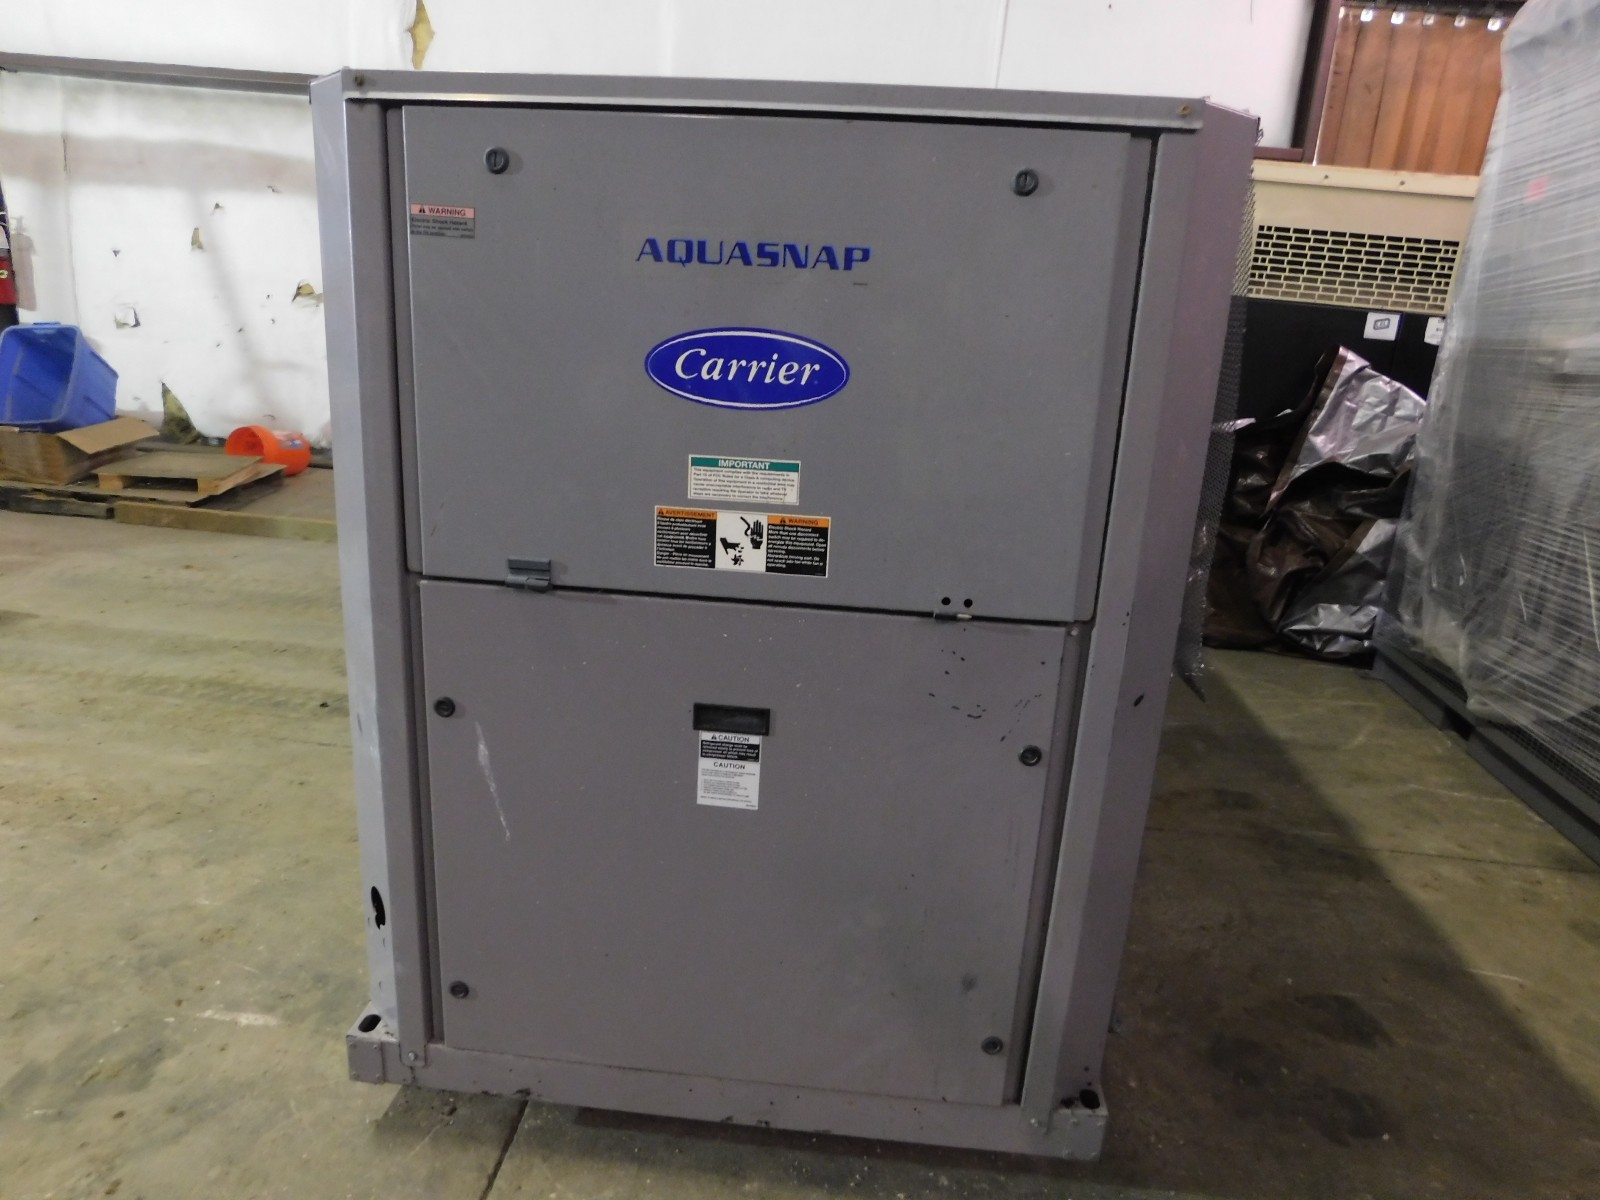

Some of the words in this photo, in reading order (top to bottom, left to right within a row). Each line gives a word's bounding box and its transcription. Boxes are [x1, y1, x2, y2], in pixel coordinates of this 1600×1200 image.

[429, 208, 465, 216] WARNING
[636, 238, 871, 271] AQUASNAP
[674, 348, 820, 386] Carrier
[718, 460, 771, 470] IMPORTANT
[665, 510, 715, 518] AVERTISSEMENT
